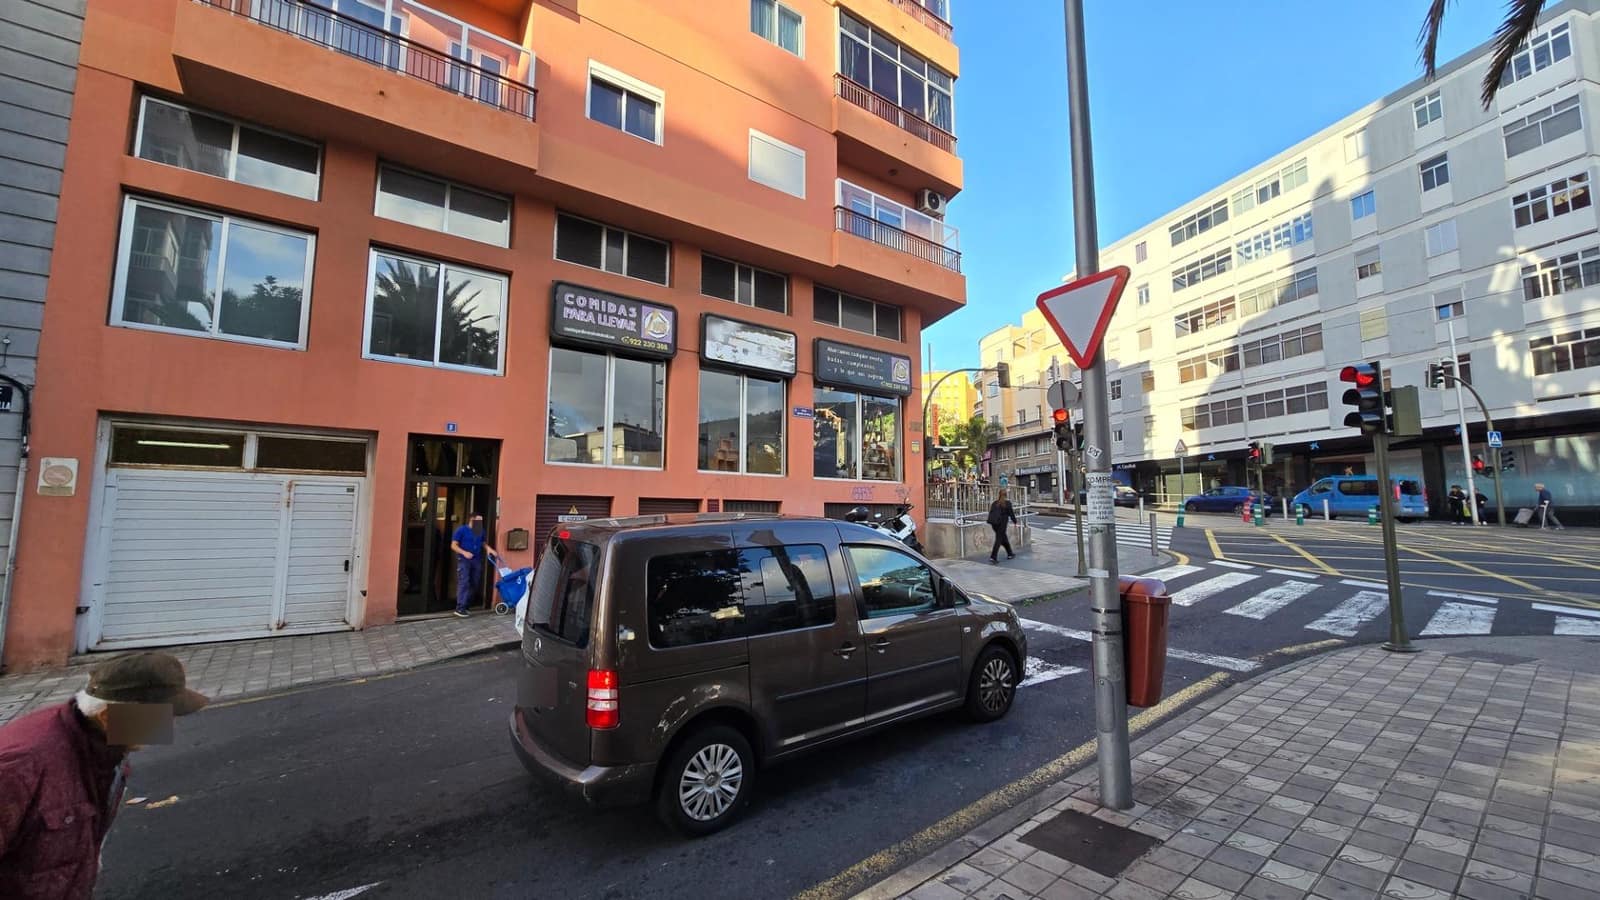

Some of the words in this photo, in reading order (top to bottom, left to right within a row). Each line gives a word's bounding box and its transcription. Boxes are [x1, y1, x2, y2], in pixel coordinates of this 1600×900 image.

[564, 293, 637, 318] COMIDAS
[563, 306, 595, 324] PARA
[598, 313, 637, 332] LLEVAR
